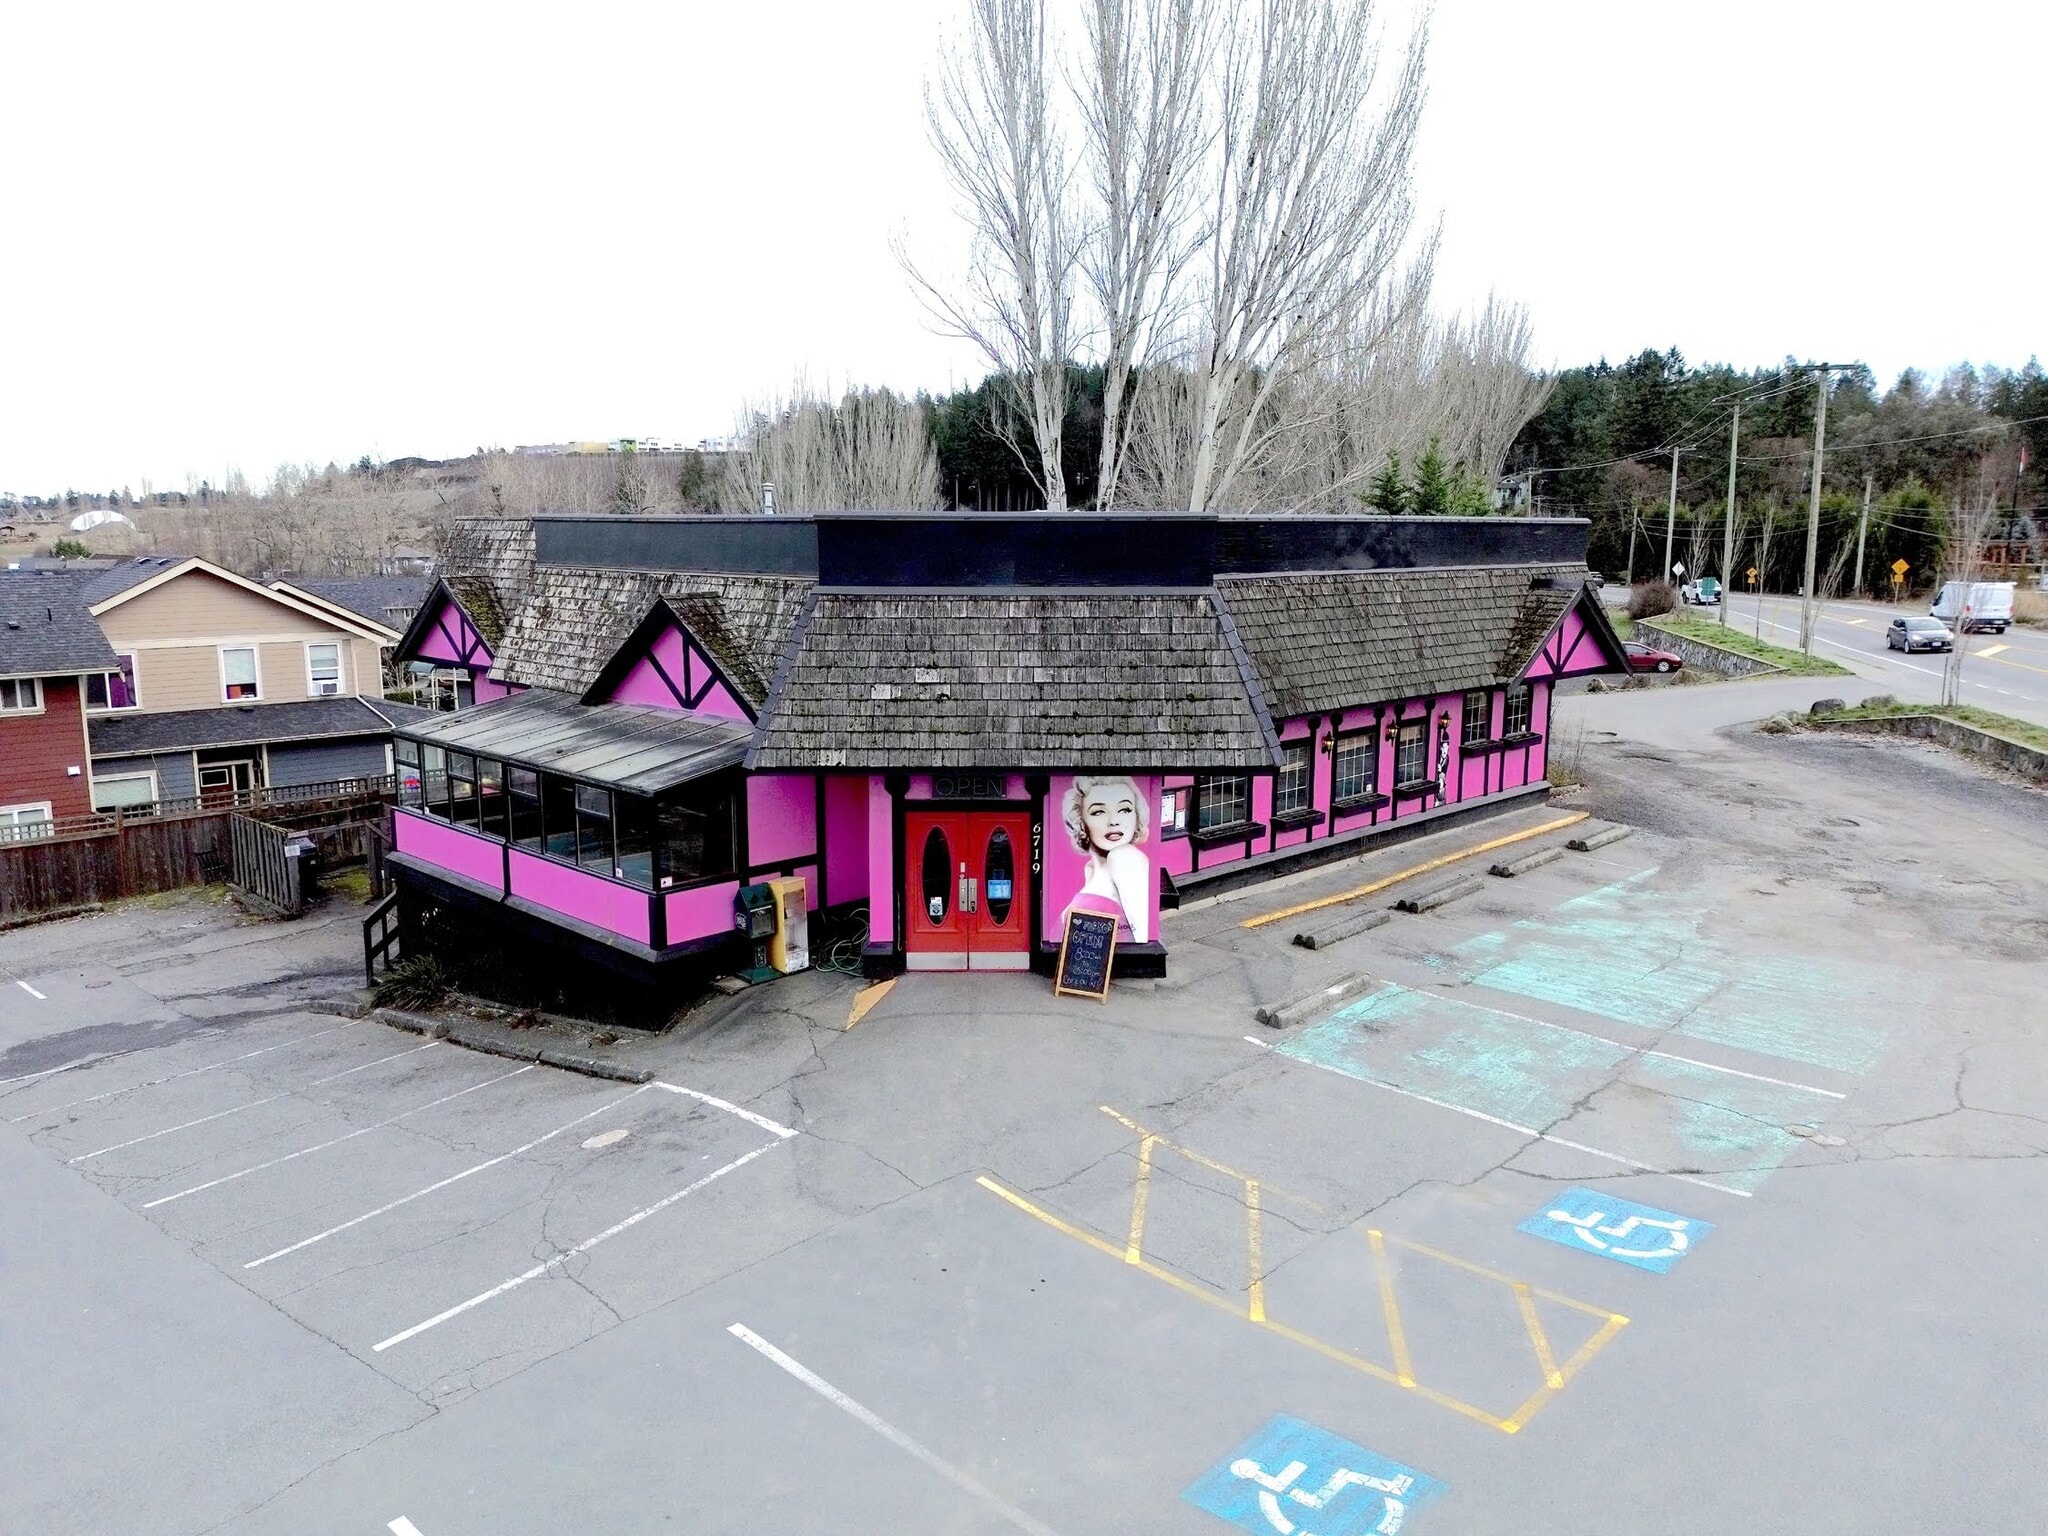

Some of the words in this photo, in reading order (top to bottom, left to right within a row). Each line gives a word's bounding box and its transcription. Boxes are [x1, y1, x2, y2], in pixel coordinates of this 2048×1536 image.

[935, 777, 1003, 796] OPEN
[1032, 822, 1042, 875] 6719
[1072, 930, 1104, 948] OPEN
